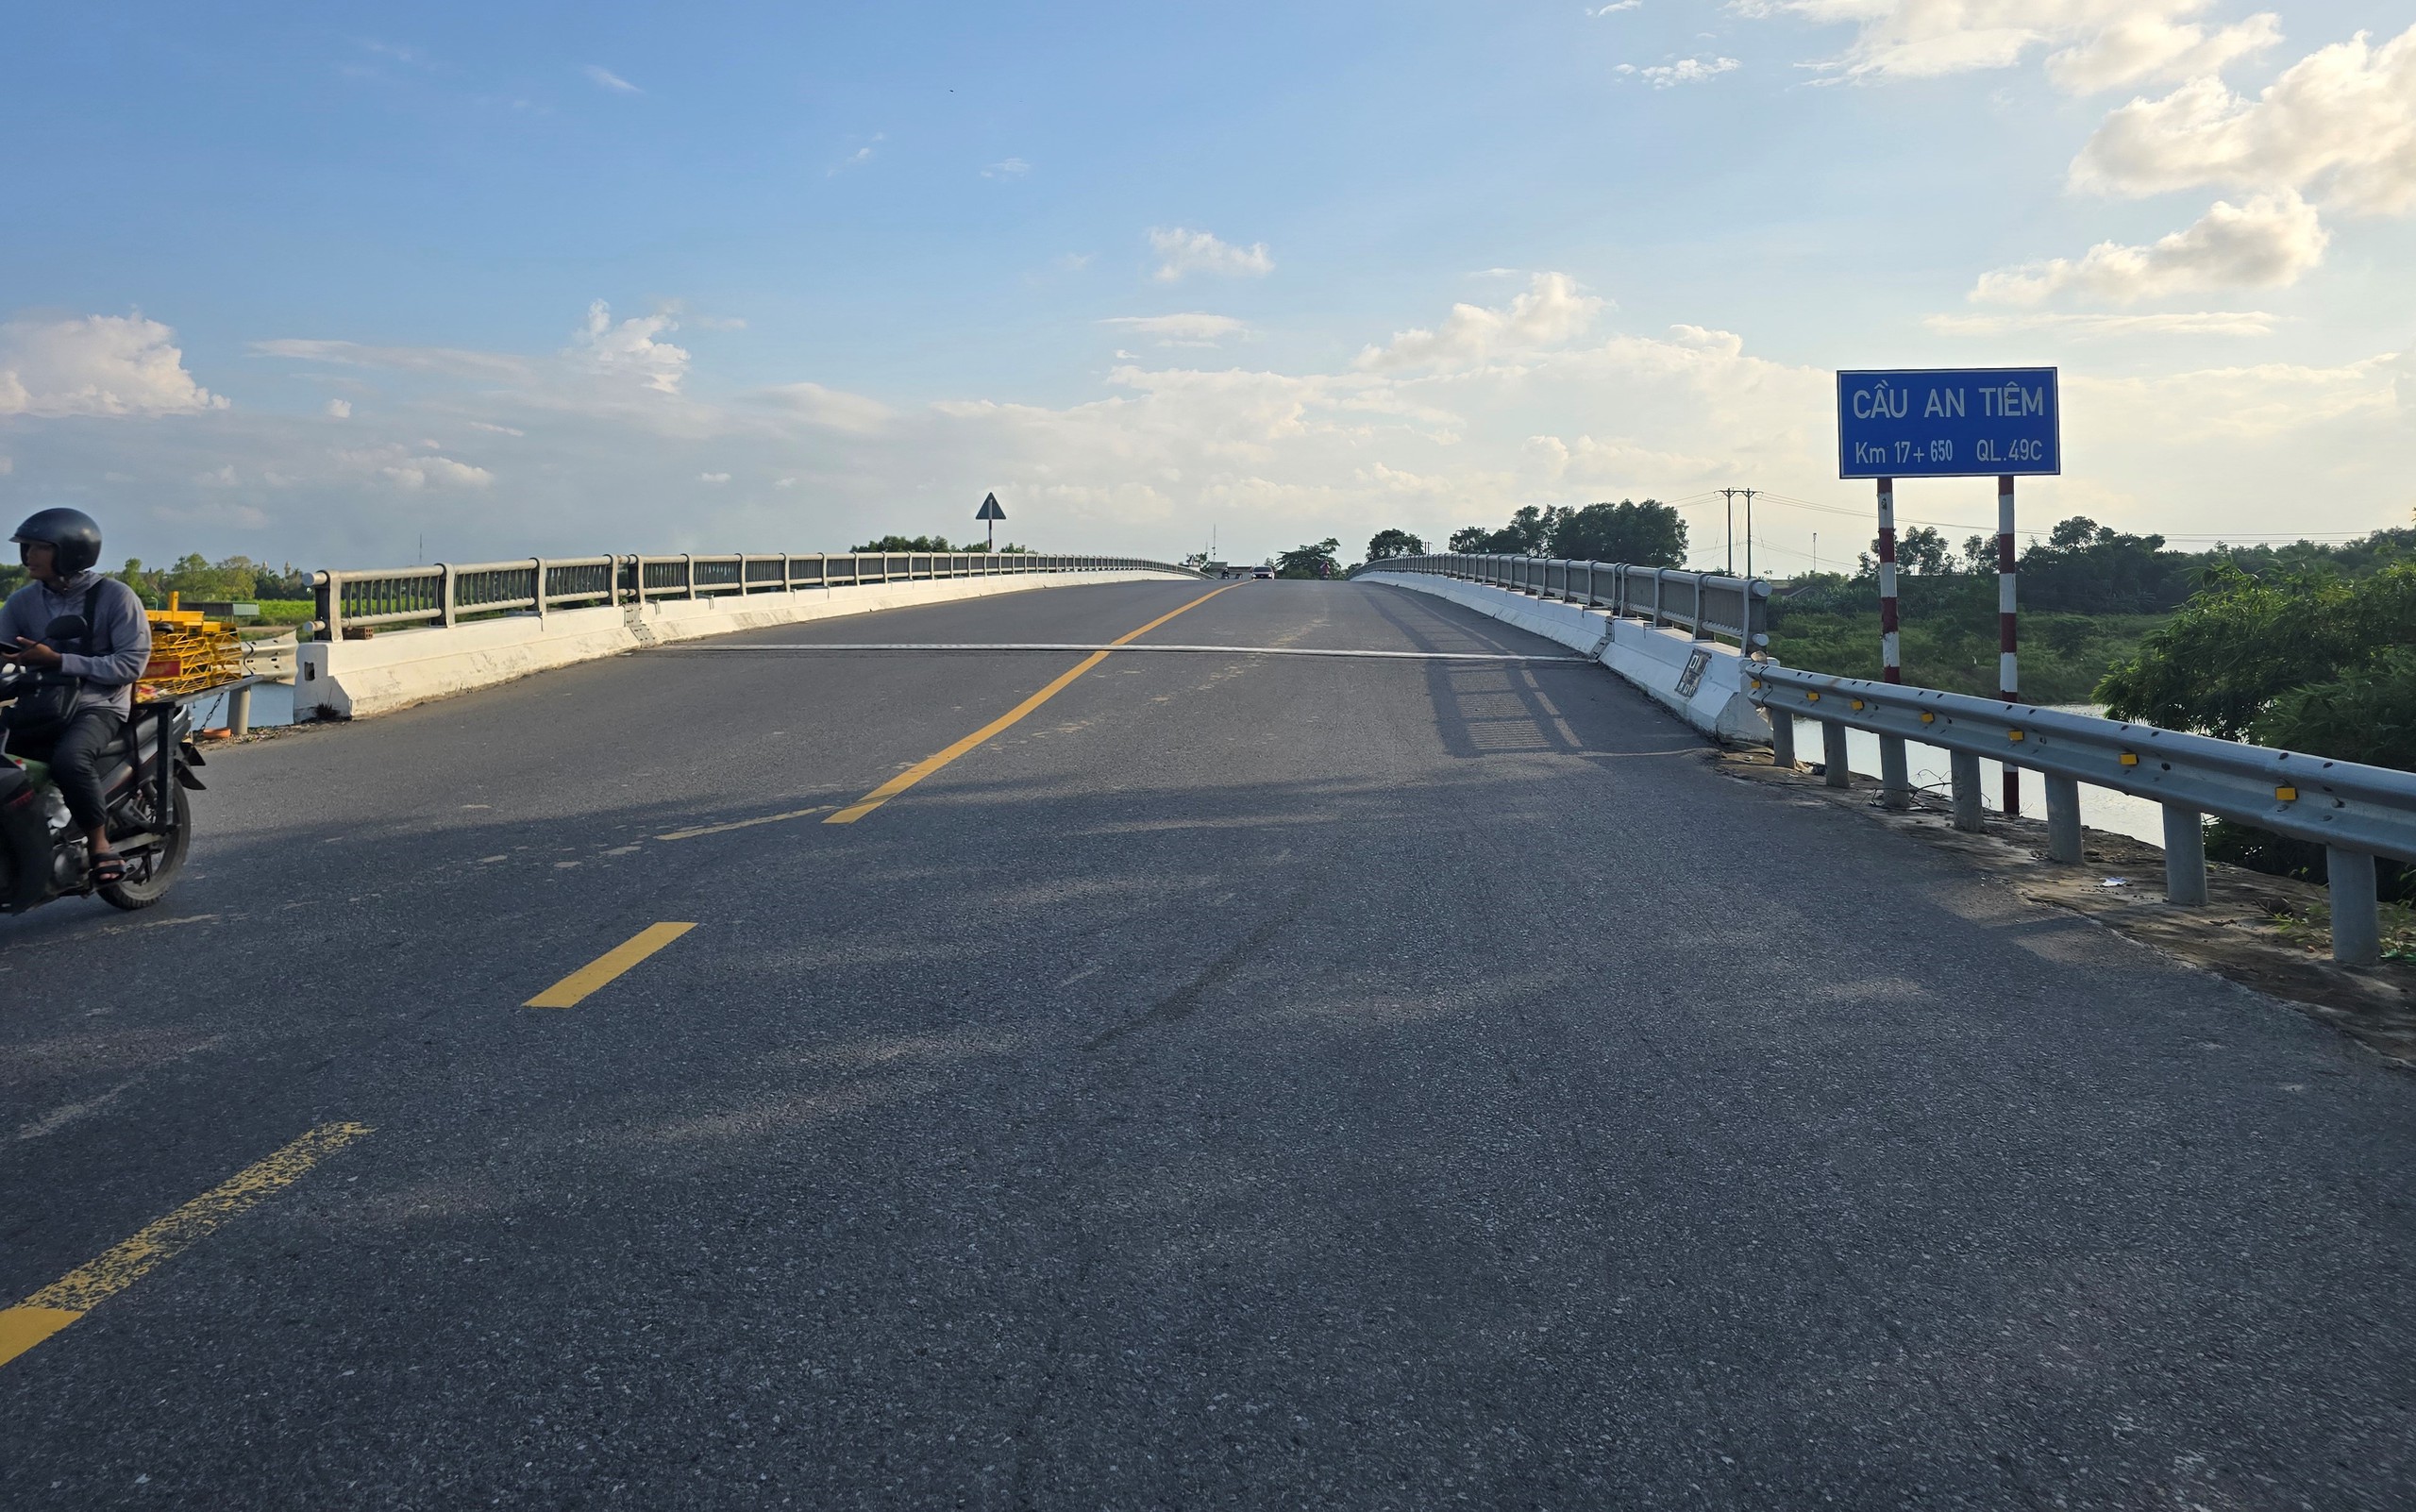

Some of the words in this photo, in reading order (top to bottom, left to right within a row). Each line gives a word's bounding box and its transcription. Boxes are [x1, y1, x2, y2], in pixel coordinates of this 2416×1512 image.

[1854, 379, 1908, 419] CẦU
[1923, 388, 1965, 418] AN
[1979, 381, 2043, 417] TIÊM
[1855, 442, 1886, 463] Km
[1976, 439, 2043, 462] QL.49C
